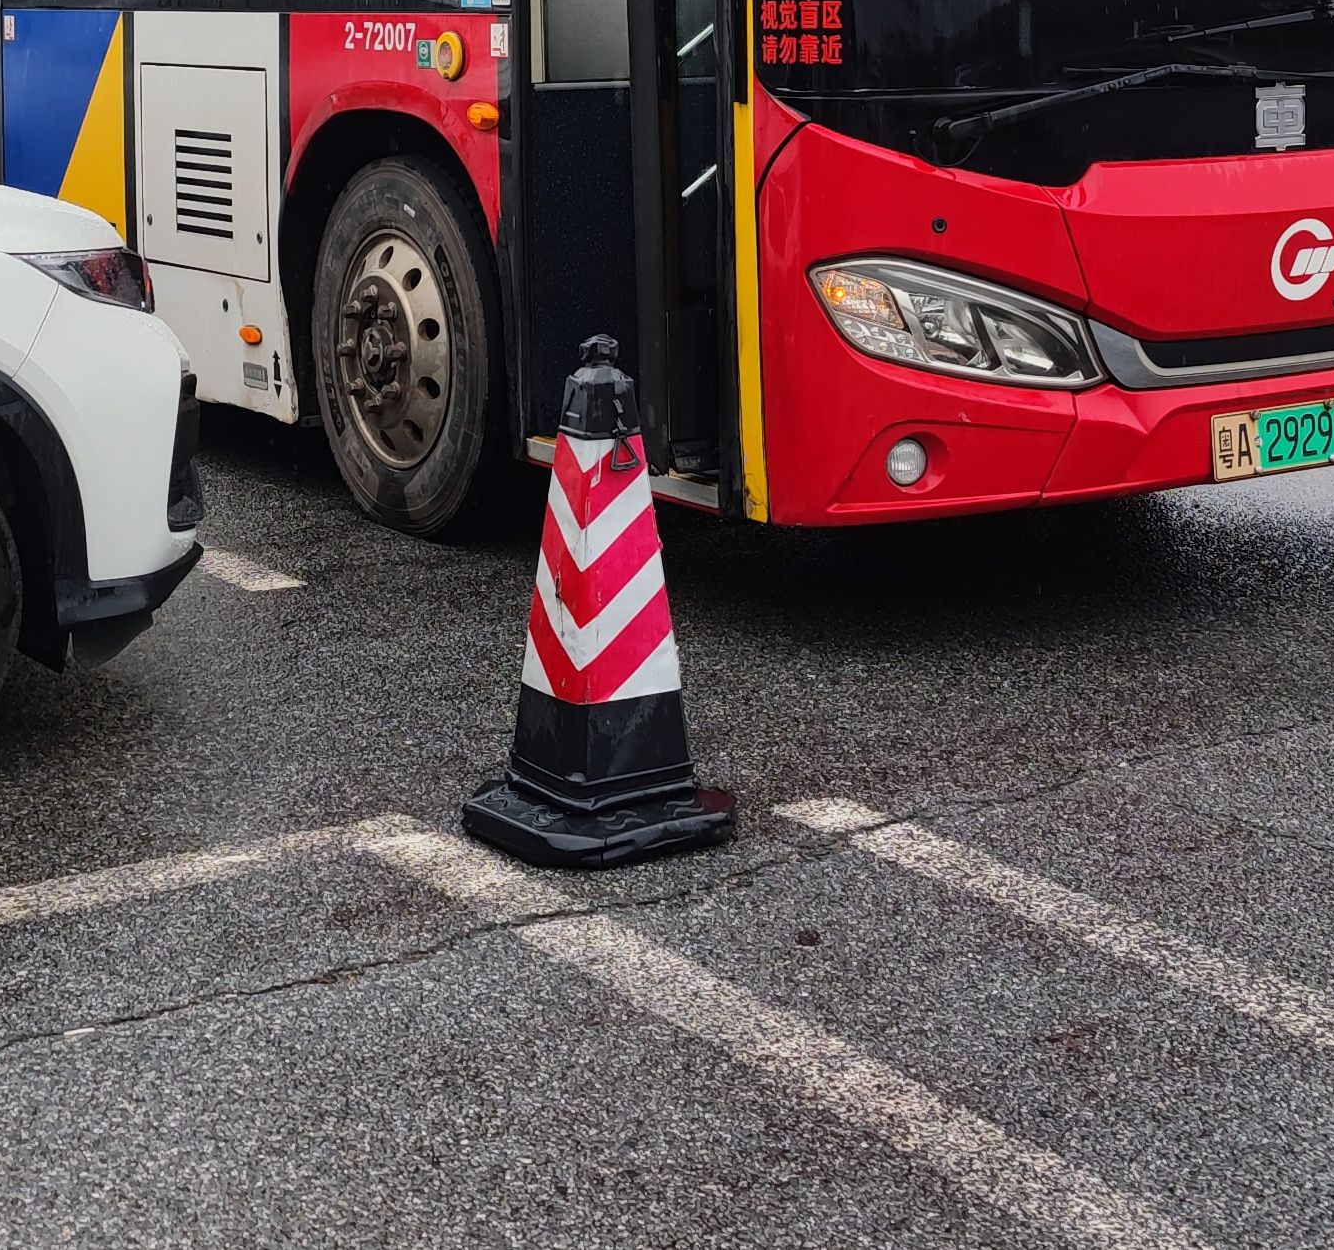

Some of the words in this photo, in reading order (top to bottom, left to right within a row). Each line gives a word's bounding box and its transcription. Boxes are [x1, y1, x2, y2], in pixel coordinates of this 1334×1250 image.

[344, 21, 416, 51] 2-72007
[761, 34, 843, 65] 请勿靠近
